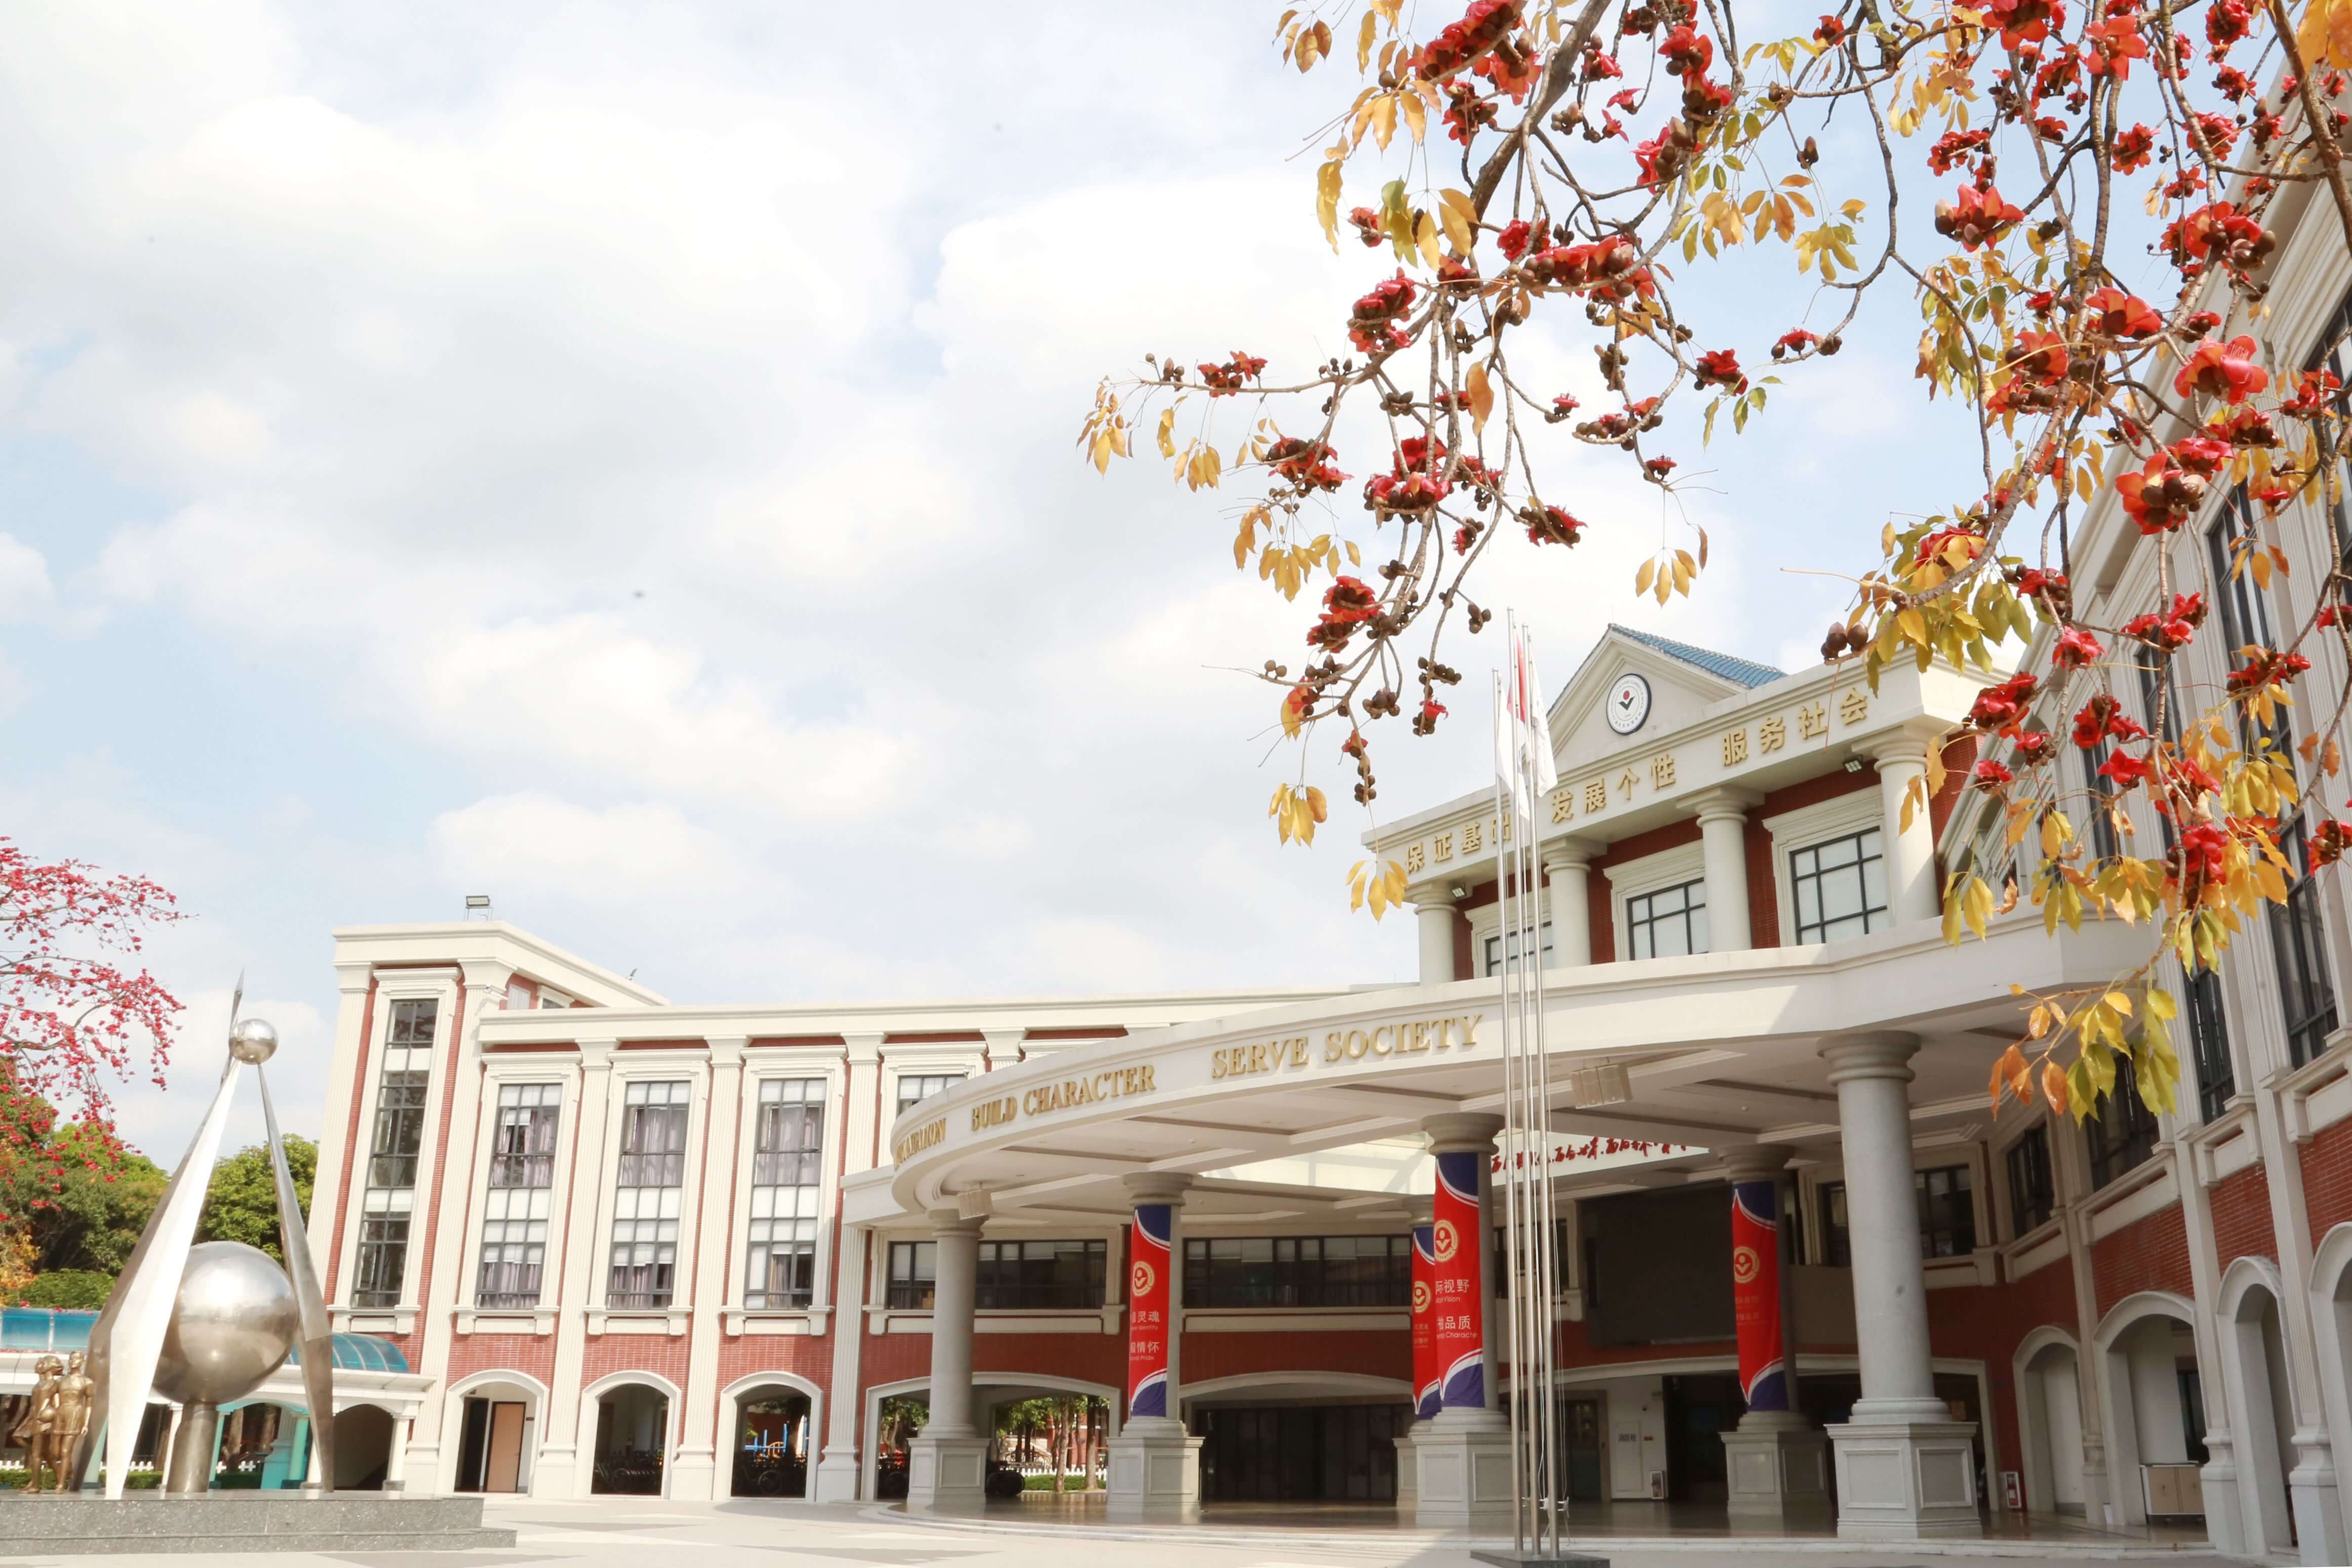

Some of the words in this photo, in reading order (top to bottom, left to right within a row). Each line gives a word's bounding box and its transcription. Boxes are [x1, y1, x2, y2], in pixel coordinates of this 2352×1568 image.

[1406, 812, 1511, 874] 保证基础
[1551, 754, 1676, 823] 发展个性
[1723, 687, 1868, 766] 服务社会
[971, 1096, 1018, 1132] BUILD
[1023, 1064, 1157, 1117] CHARACTER
[1211, 1037, 1309, 1079] SERVE
[1325, 1014, 1482, 1062] SOCIETY
